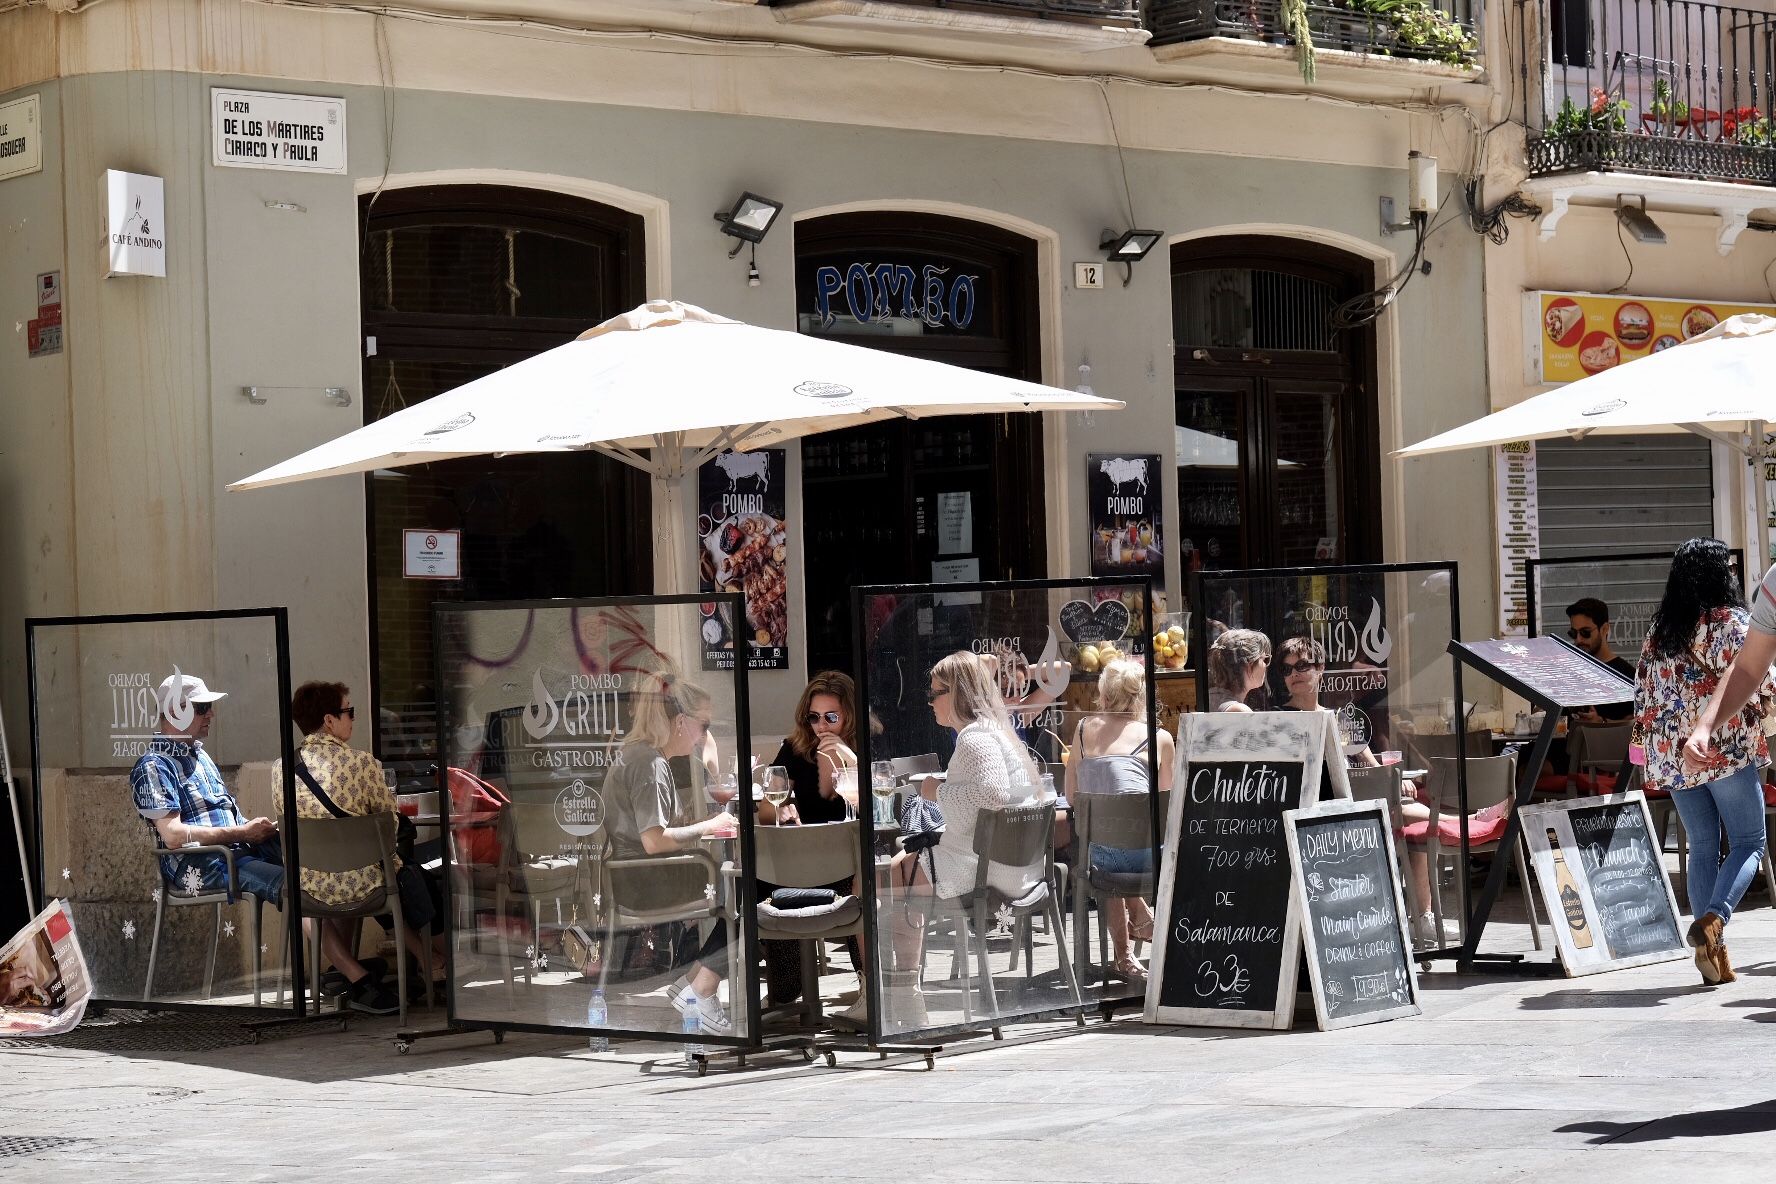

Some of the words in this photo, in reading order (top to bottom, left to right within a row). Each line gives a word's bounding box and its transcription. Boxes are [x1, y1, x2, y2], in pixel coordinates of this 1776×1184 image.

[223, 100, 250, 114] PLAZA
[224, 118, 238, 135] DE
[241, 119, 263, 137] LOS
[267, 120, 324, 142] MÁRTIRES
[0, 136, 26, 159] OSQUERA
[224, 138, 267, 158] CIRIACO
[271, 142, 279, 159] Y
[283, 142, 318, 162] PAULA
[112, 232, 132, 246] CAFÉ
[133, 237, 163, 250] ANDINO
[1083, 267, 1096, 284] 12
[815, 262, 980, 330] POMBO
[722, 493, 764, 514] POMBO
[1107, 496, 1143, 515] POMBO
[1619, 603, 1656, 616] POMBO
[1614, 616, 1646, 647] GRIL
[706, 651, 726, 659] OFERTAS
[571, 673, 622, 690] POMBO
[562, 690, 625, 736] GRILL
[532, 750, 626, 768] GASTROBAR
[1191, 763, 1288, 805] Chuletón
[562, 795, 597, 810] Estrella
[563, 810, 596, 824] Galicia
[1189, 818, 1208, 835] DE
[1306, 831, 1339, 859] DAILY
[1200, 844, 1240, 872] 700
[1328, 873, 1374, 901] Starter
[1215, 891, 1236, 906] DE
[1175, 917, 1280, 945] Salamanca
[1194, 954, 1251, 997] 33€
